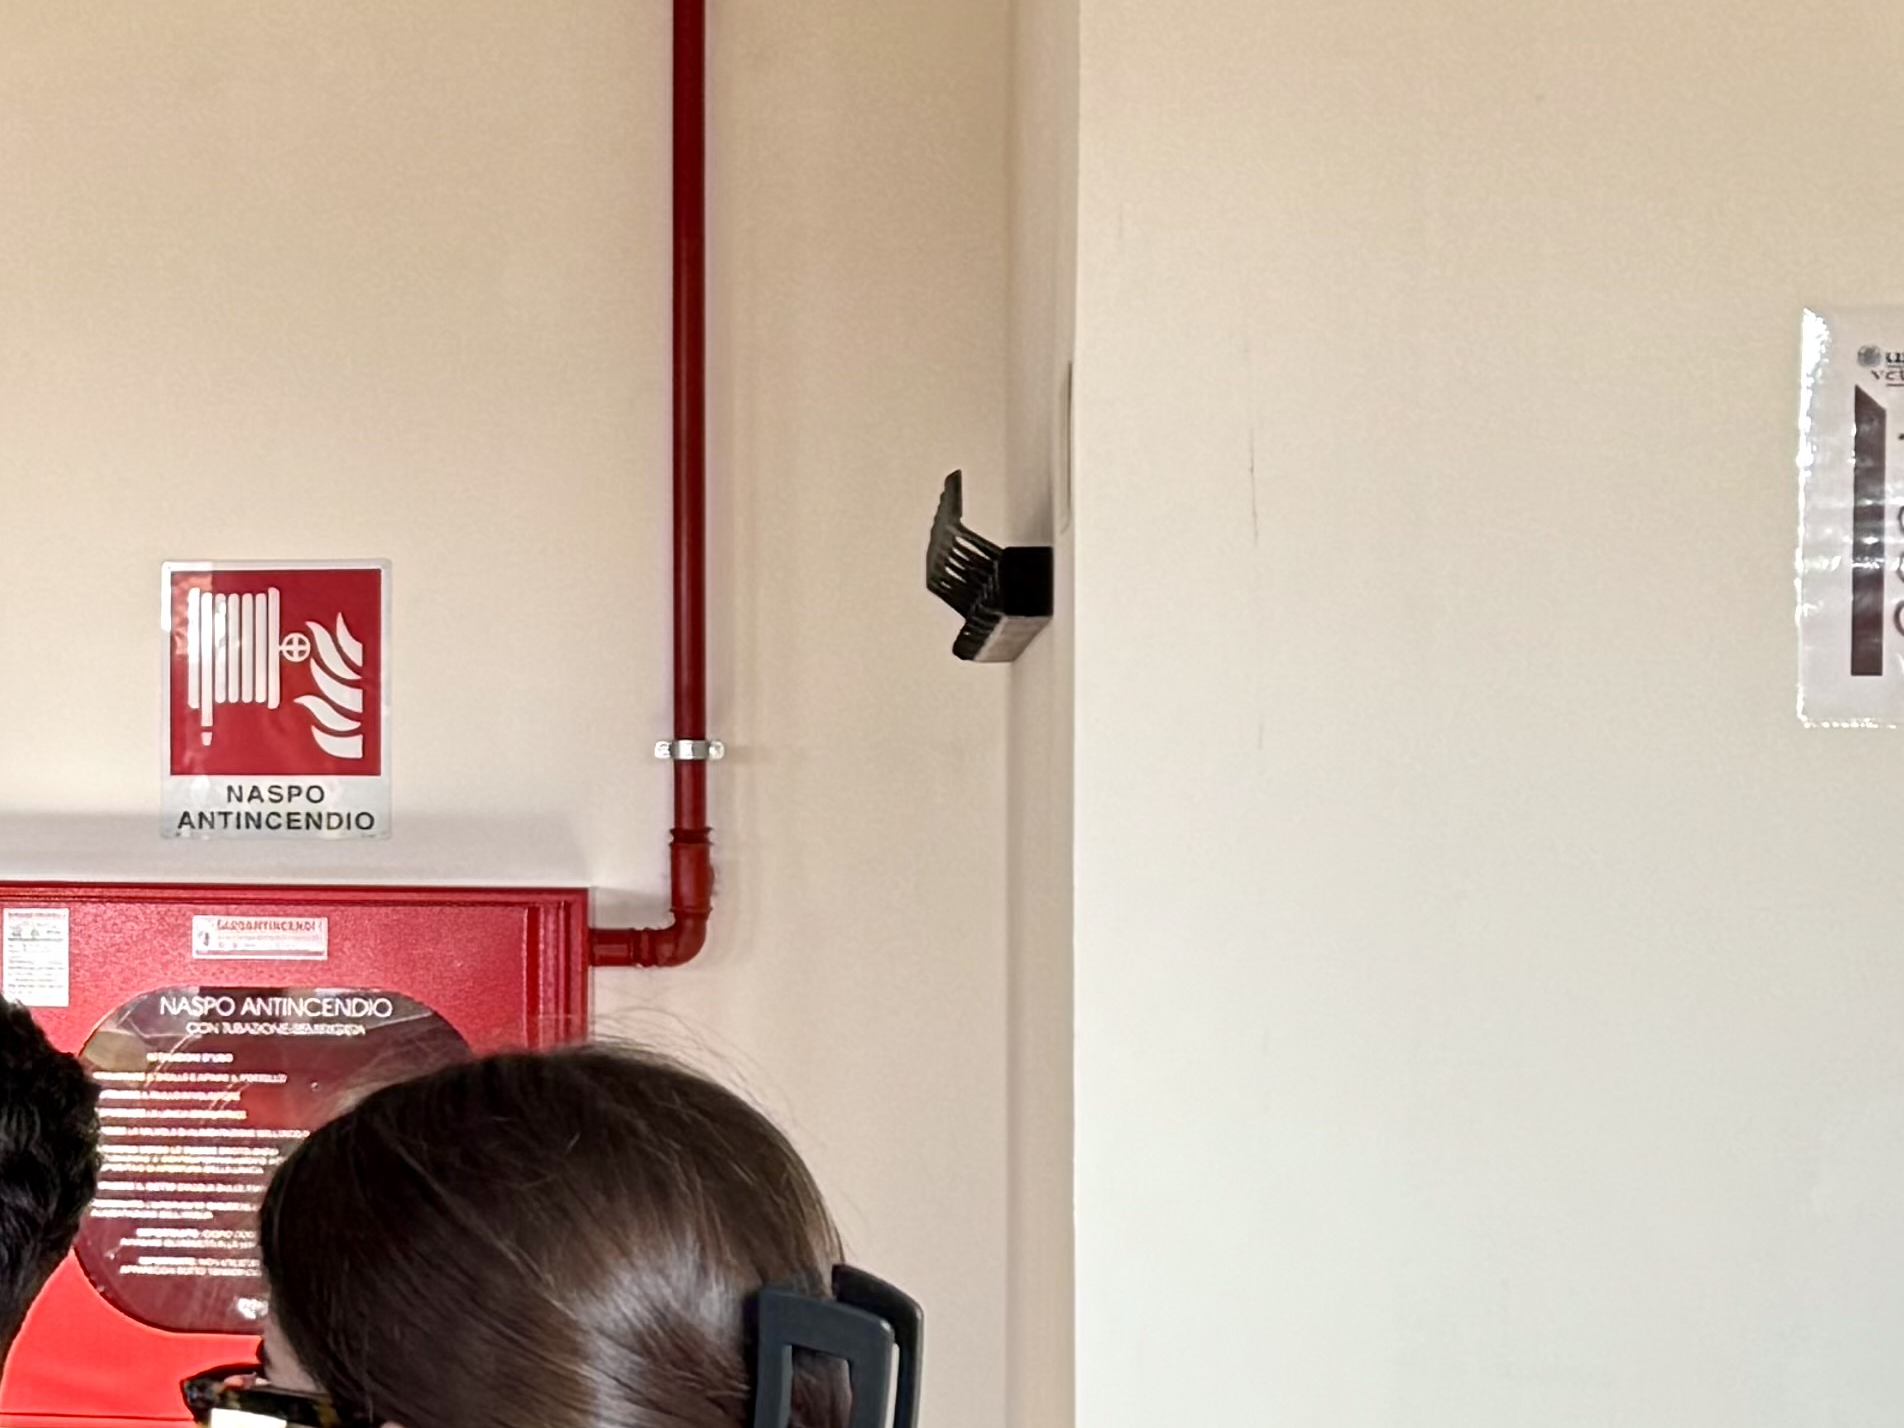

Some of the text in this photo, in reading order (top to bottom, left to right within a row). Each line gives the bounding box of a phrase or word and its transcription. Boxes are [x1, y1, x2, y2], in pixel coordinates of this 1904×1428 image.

[225, 784, 325, 804] NASPO
[177, 810, 376, 831] ANTINCENDIO
[159, 997, 393, 1018] NASPO ANTINCENDIO
[185, 1022, 219, 1035] CON
